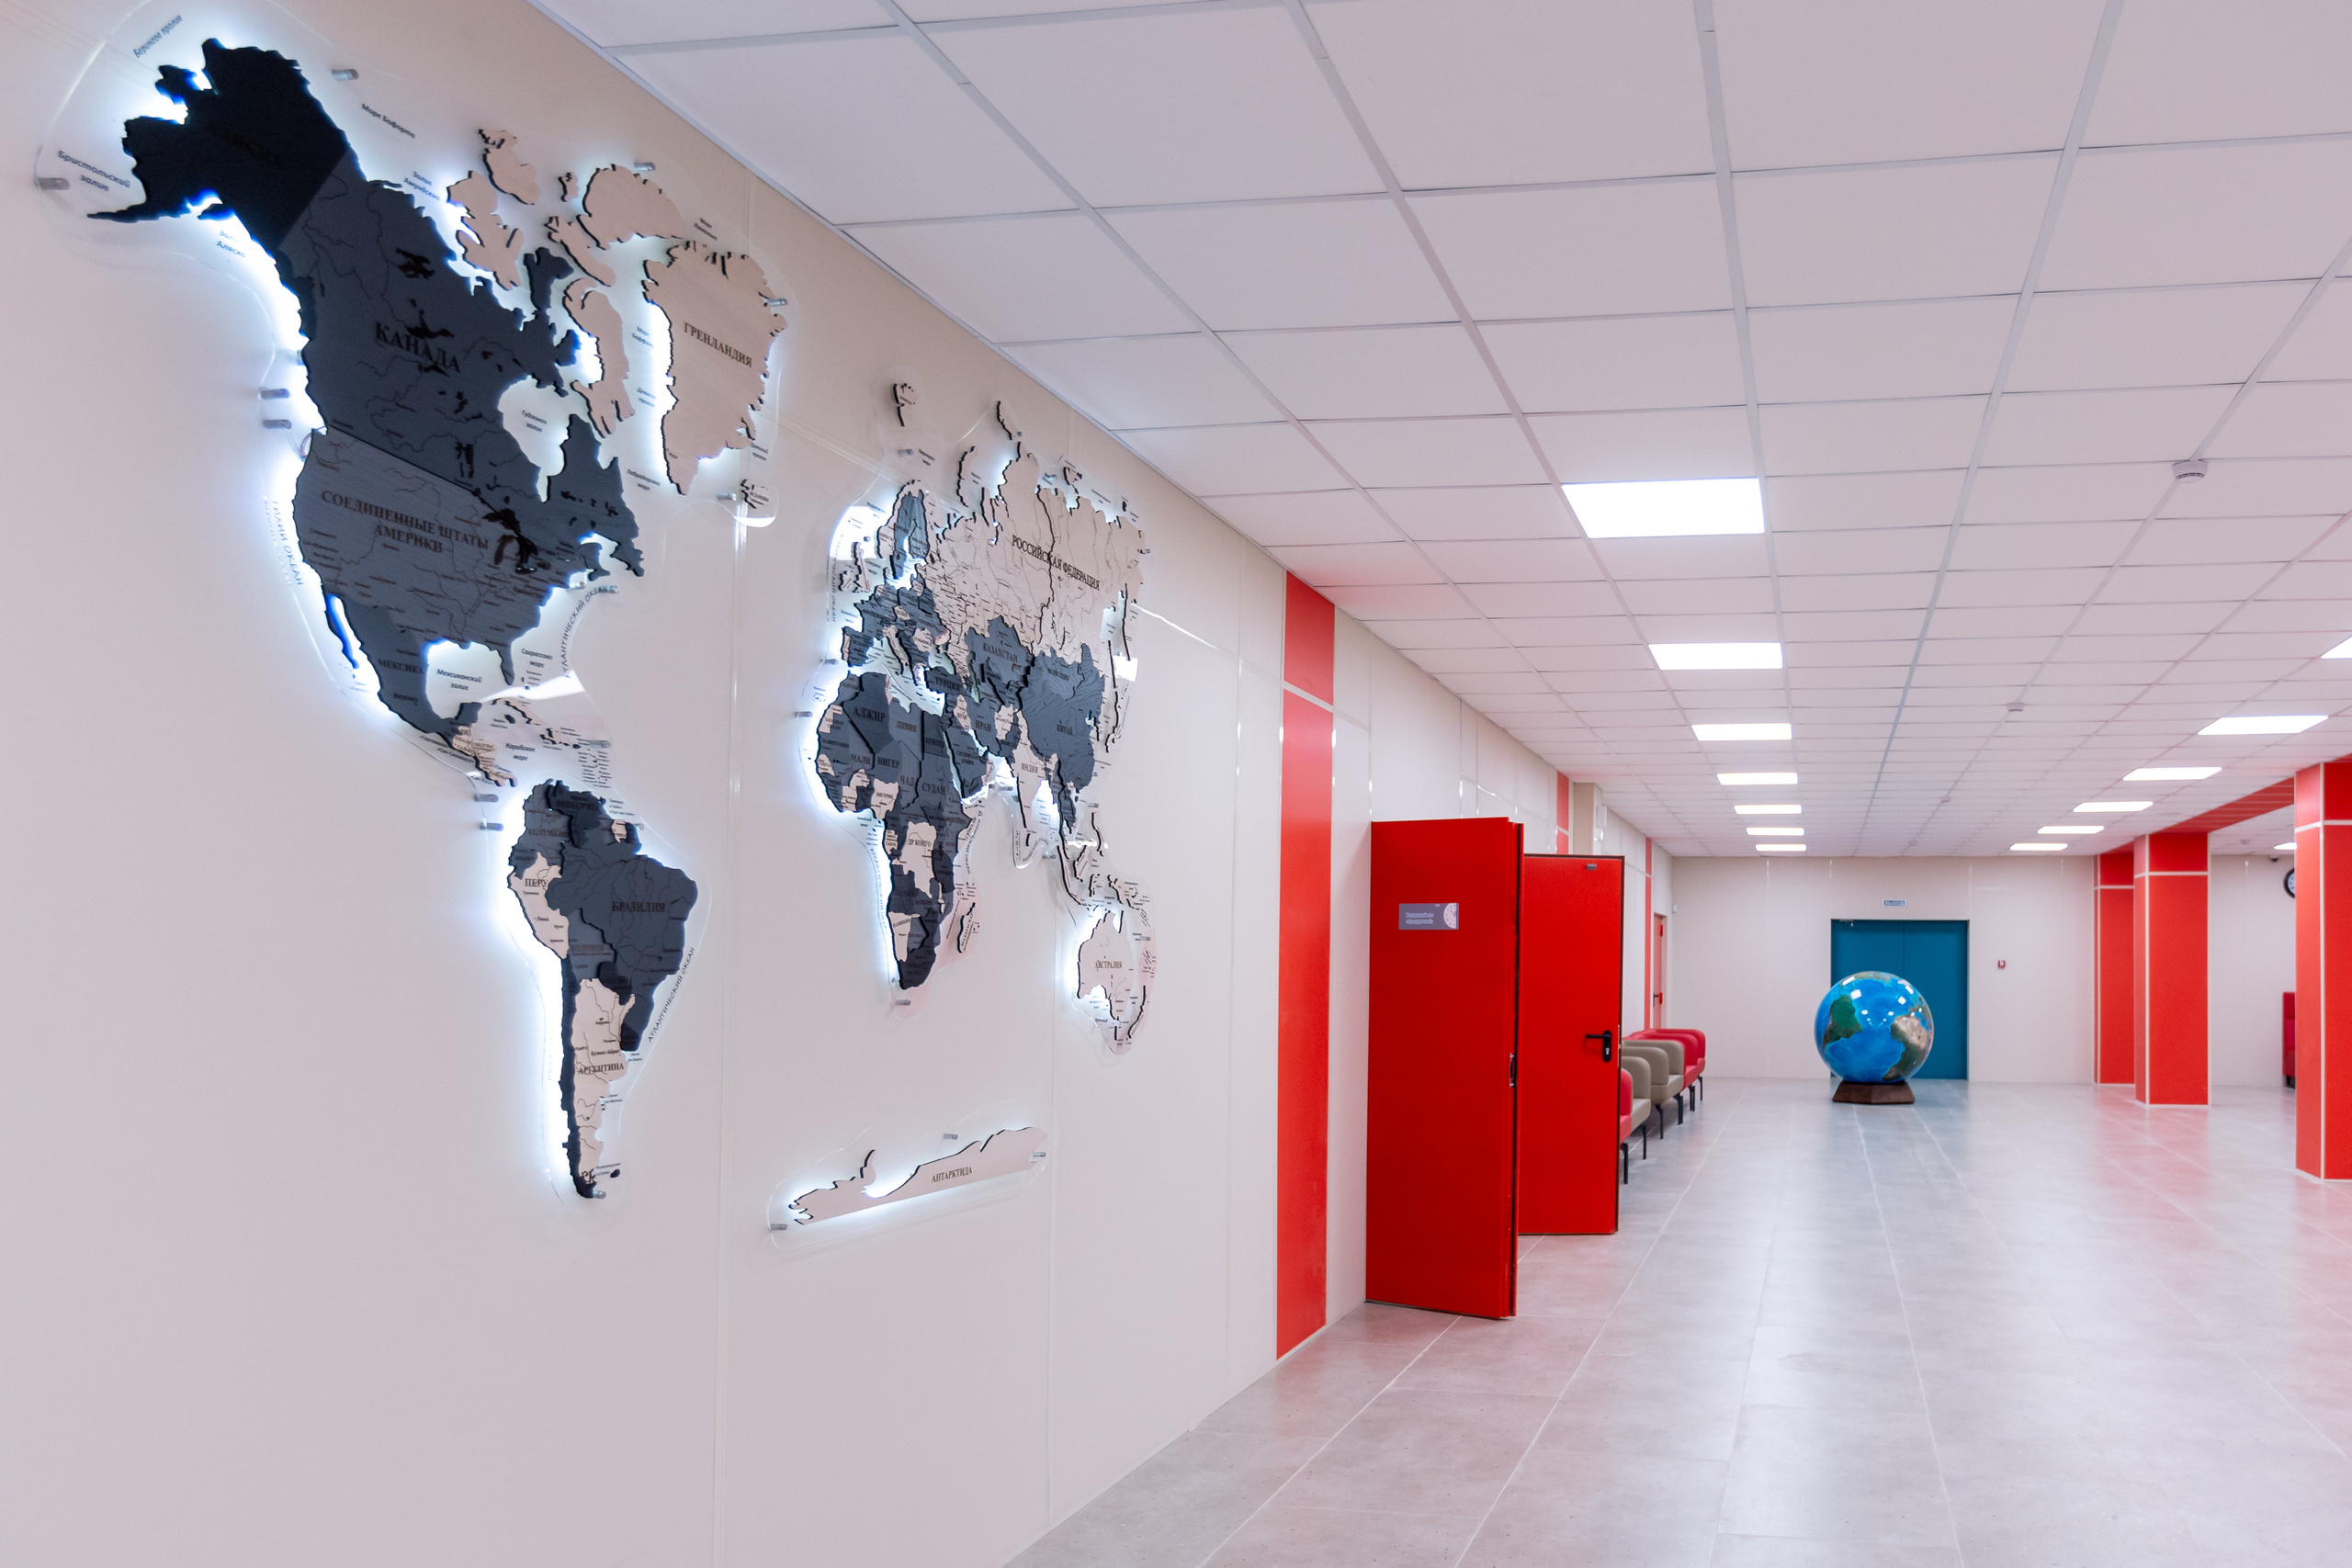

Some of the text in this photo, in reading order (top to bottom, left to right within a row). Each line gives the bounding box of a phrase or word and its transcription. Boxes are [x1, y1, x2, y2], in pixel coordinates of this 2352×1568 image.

[58, 150, 130, 189] Бристольский
[80, 175, 109, 192] залив
[375, 321, 461, 374] КАНАДА
[684, 321, 752, 368] ГРЕНЛАНДИЯ
[322, 490, 489, 551] СОЕДИНЕННЫЕ ШТАТЫ
[373, 524, 444, 554] АМЕРИКИ
[283, 545, 305, 586] ОКЕАН
[1012, 534, 1101, 592] РОССИЙСКАЯ ФЕДЕРАЦИЯ
[854, 705, 887, 724] АЛЖИР
[877, 756, 900, 769] НИГЕР
[922, 782, 946, 795] СУДАН
[525, 877, 548, 887] ПЕРУ
[612, 901, 666, 913] БРАЗИЛИЯ
[681, 946, 695, 976] ОКЕАН
[578, 1063, 625, 1075] АРГЕНТИНА
[931, 1166, 973, 1183] АНТАРКТИДА
